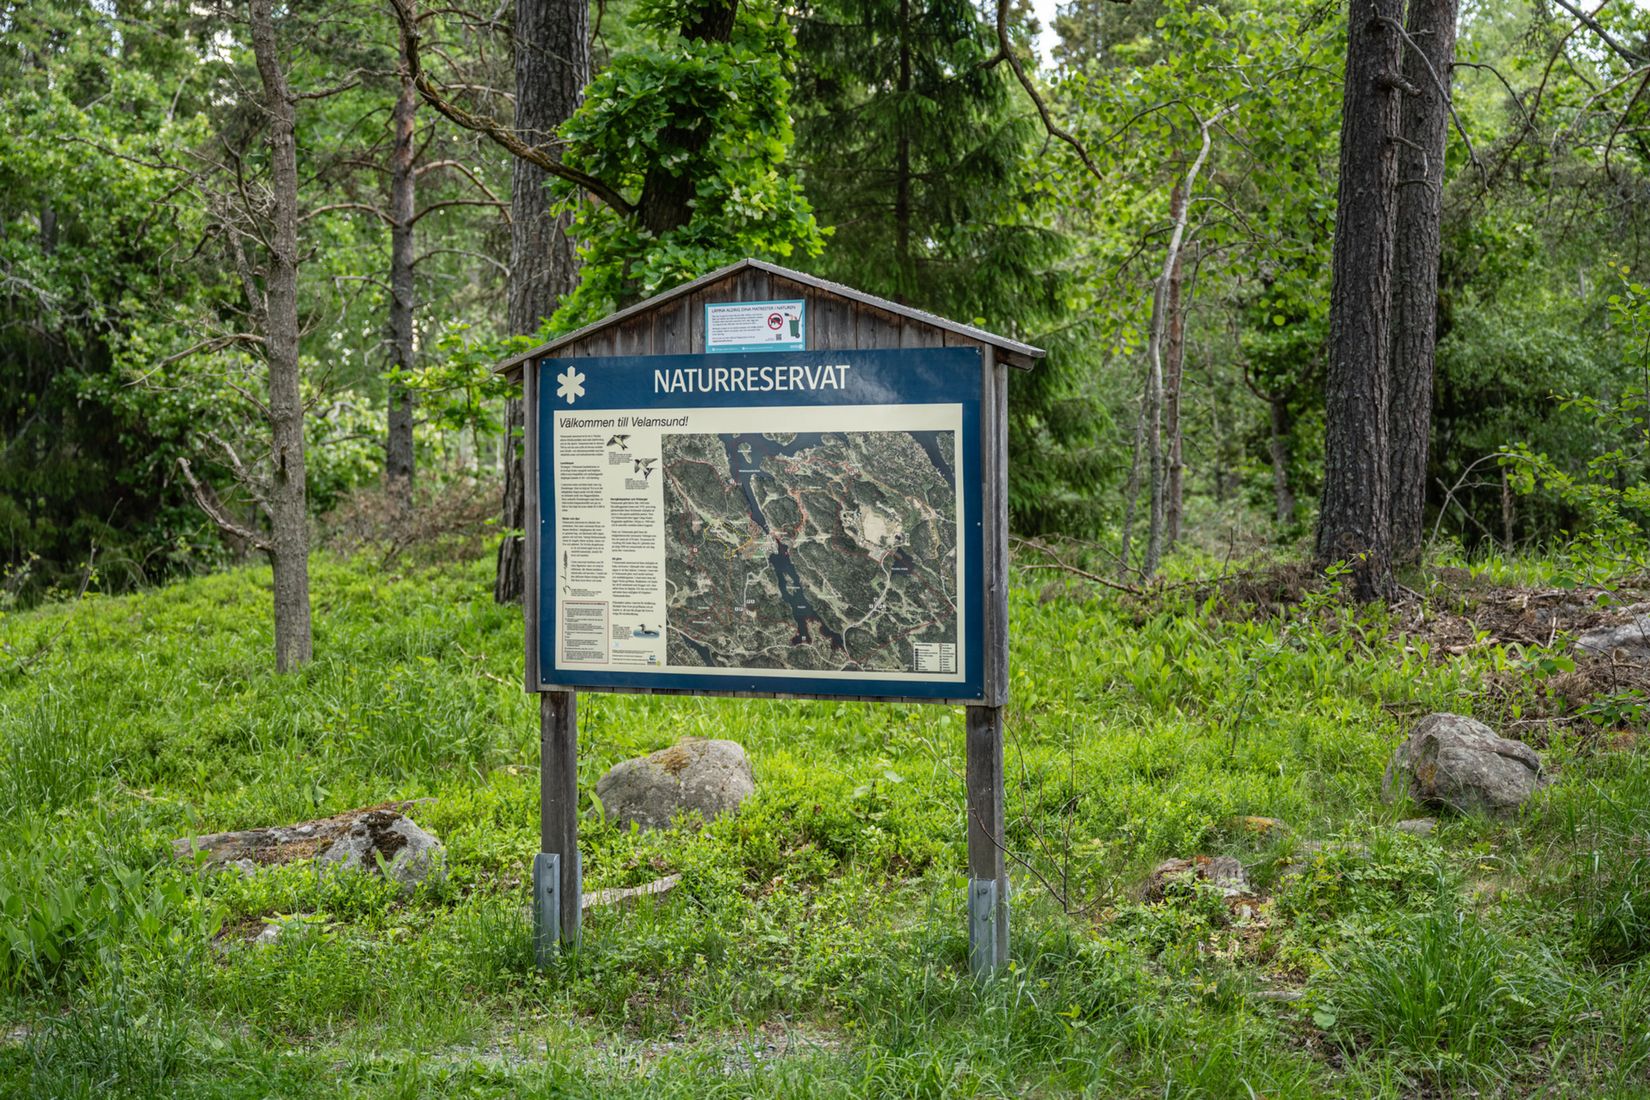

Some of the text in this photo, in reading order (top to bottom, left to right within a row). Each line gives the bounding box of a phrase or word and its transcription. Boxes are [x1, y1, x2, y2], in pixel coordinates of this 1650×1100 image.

[654, 365, 851, 393] NATURRESERVAT
[559, 416, 689, 428] Välkommen till Velamsund!
